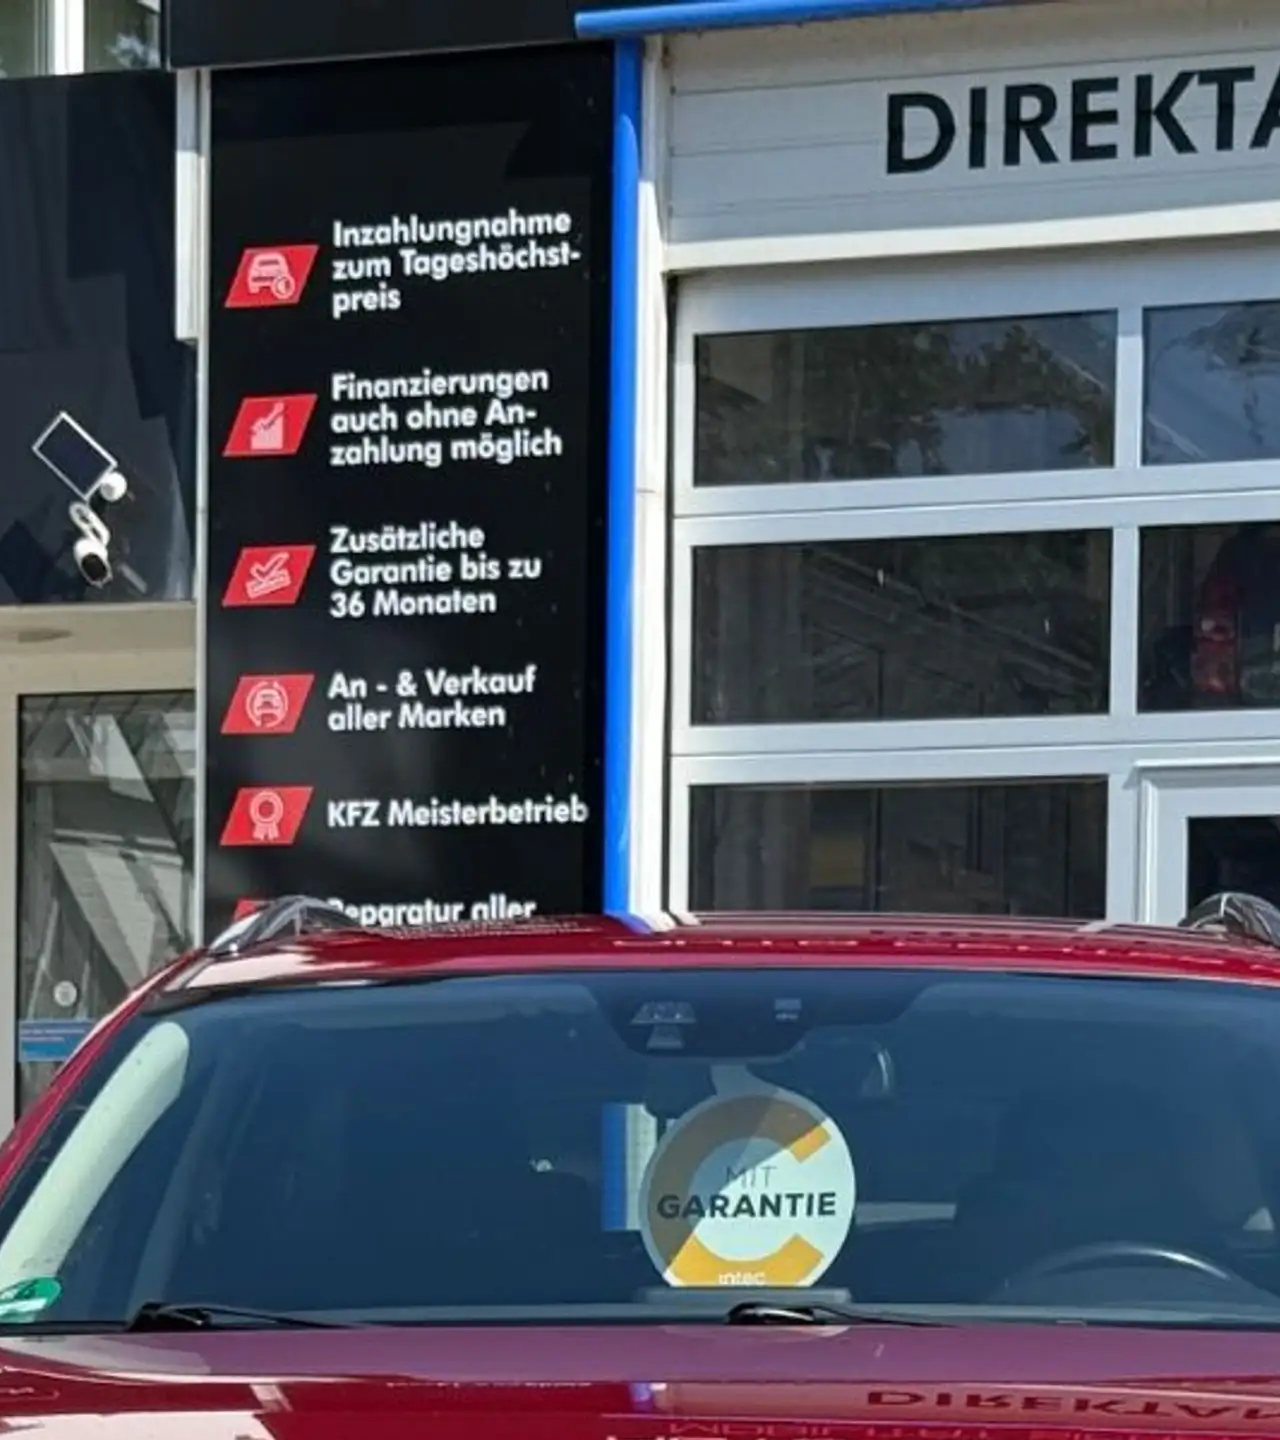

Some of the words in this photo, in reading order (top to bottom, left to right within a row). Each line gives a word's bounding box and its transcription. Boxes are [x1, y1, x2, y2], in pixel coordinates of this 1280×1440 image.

[333, 207, 571, 247] Inzahlungnahme
[332, 255, 391, 281] zum
[399, 241, 581, 280] Tageshöchst-
[332, 282, 401, 319] preis
[332, 367, 548, 401] Finanzierungen
[331, 404, 398, 433] auch
[406, 402, 477, 429] ohne
[484, 399, 537, 426] An-
[330, 435, 442, 468] zahlung
[451, 428, 562, 464] möglich
[330, 521, 485, 554] Zusätzliche
[330, 555, 452, 586] Garantie
[460, 554, 501, 581] bis
[508, 556, 542, 579] zu
[329, 592, 366, 619] 36
[373, 588, 497, 617] Monaten
[327, 671, 367, 700] An
[396, 671, 418, 697] &
[425, 663, 539, 696] Verkauf
[327, 702, 392, 732] aller
[398, 701, 506, 730] Marken
[327, 800, 380, 828] KFZ
[388, 793, 589, 827] Meisterbetrieb
[726, 1166, 777, 1188] MIT
[657, 1192, 836, 1219] GARANTIE
